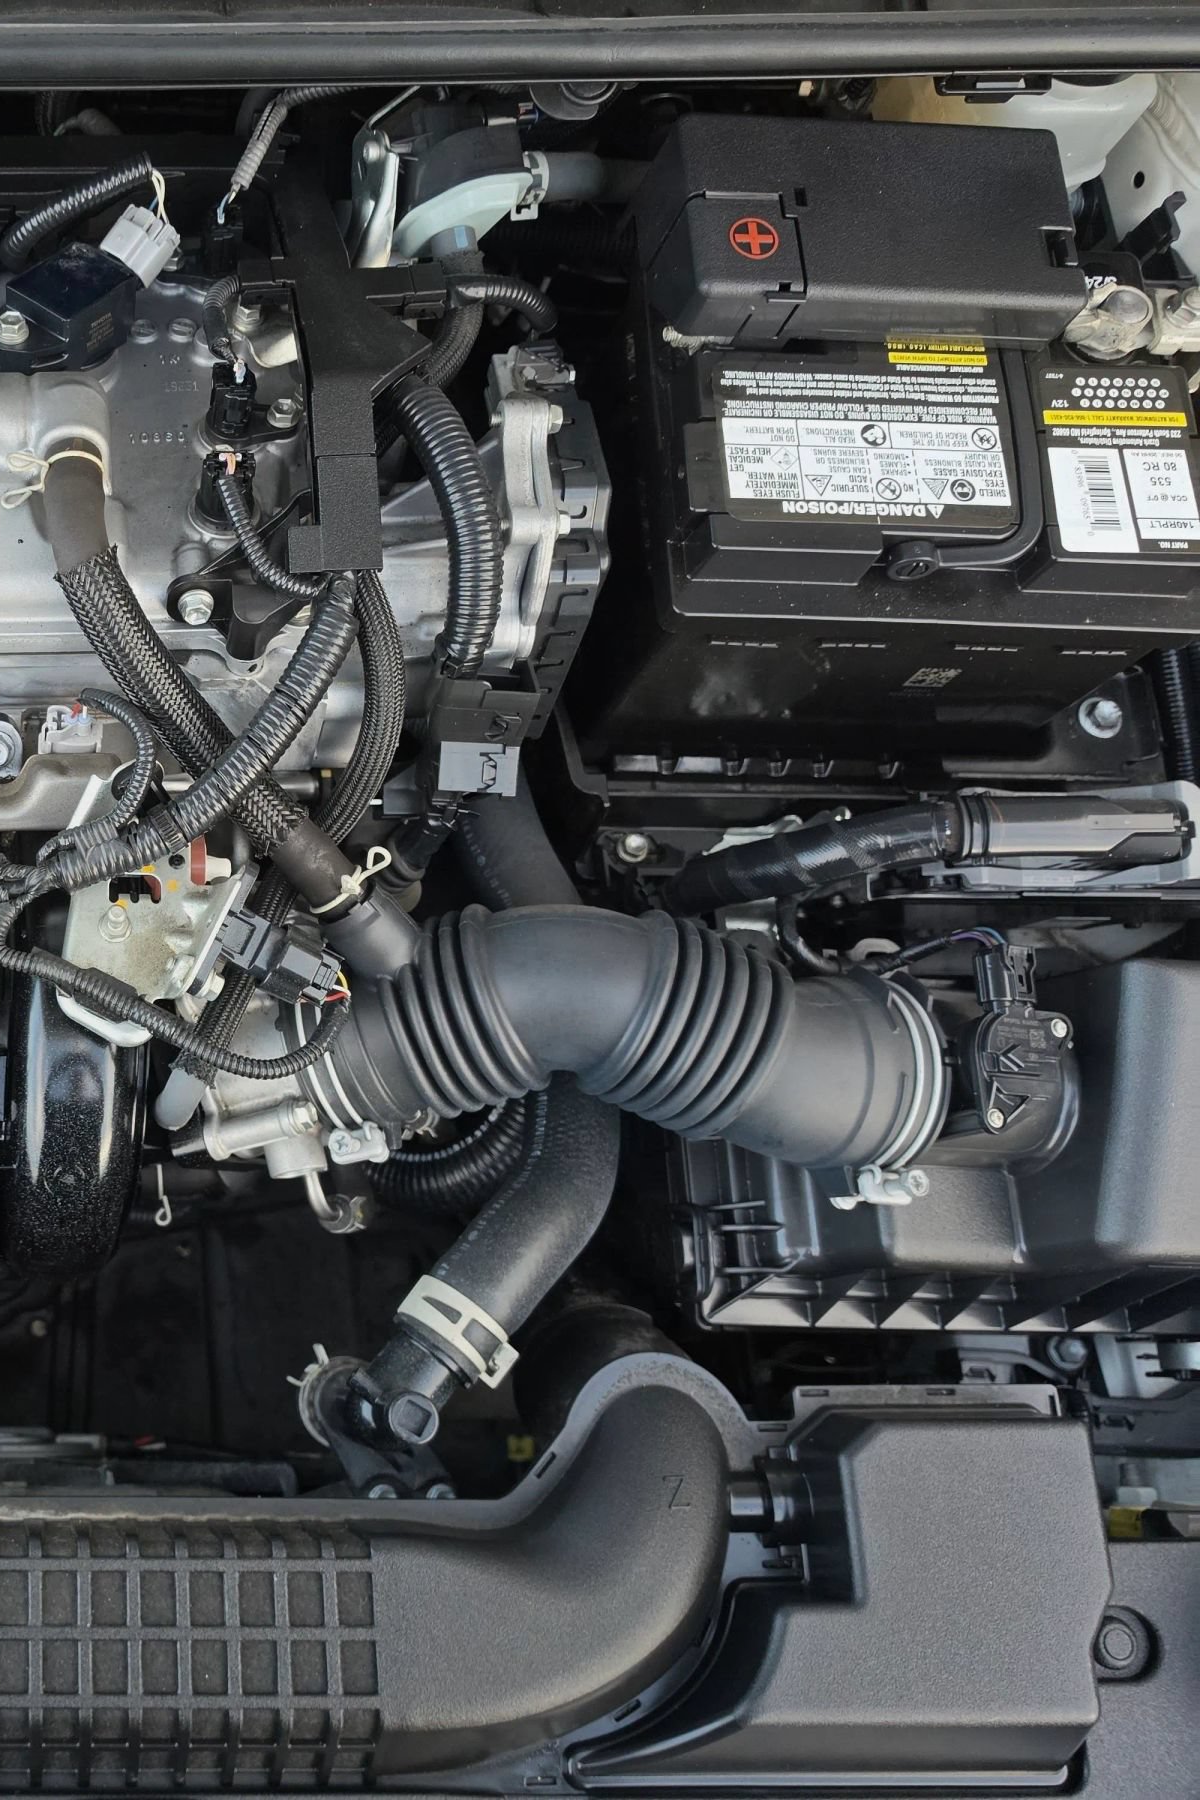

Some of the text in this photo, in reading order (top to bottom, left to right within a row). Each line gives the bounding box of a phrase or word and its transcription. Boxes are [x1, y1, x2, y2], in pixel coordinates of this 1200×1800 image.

[1050, 399, 1070, 408] 12V
[775, 426, 794, 434] OPEN
[769, 434, 796, 443] DO NOT
[836, 436, 856, 444] READ
[945, 431, 968, 440] REACH
[951, 440, 969, 448] KEEP
[726, 445, 772, 455] HELP FAST.
[727, 455, 764, 464] MEDICAL
[729, 464, 744, 472] GET
[828, 465, 851, 473] CAUSE
[1142, 461, 1177, 471] 80 RC
[744, 471, 798, 481] WITH WATER.
[933, 468, 1003, 478] EXPLOSIVE GASES
[848, 474, 868, 483] ACID
[1149, 476, 1172, 487] 535
[744, 479, 799, 490] IMMEDIATELY
[830, 483, 870, 492] SULFURIC
[752, 489, 800, 499] FLUSH EYES
[978, 488, 1007, 498] SHIELD
[1170, 494, 1188, 502] CCA
[781, 501, 927, 517] DANGER/POISON
[1149, 520, 1194, 529] 140RPLT
[1170, 540, 1189, 549] PART
